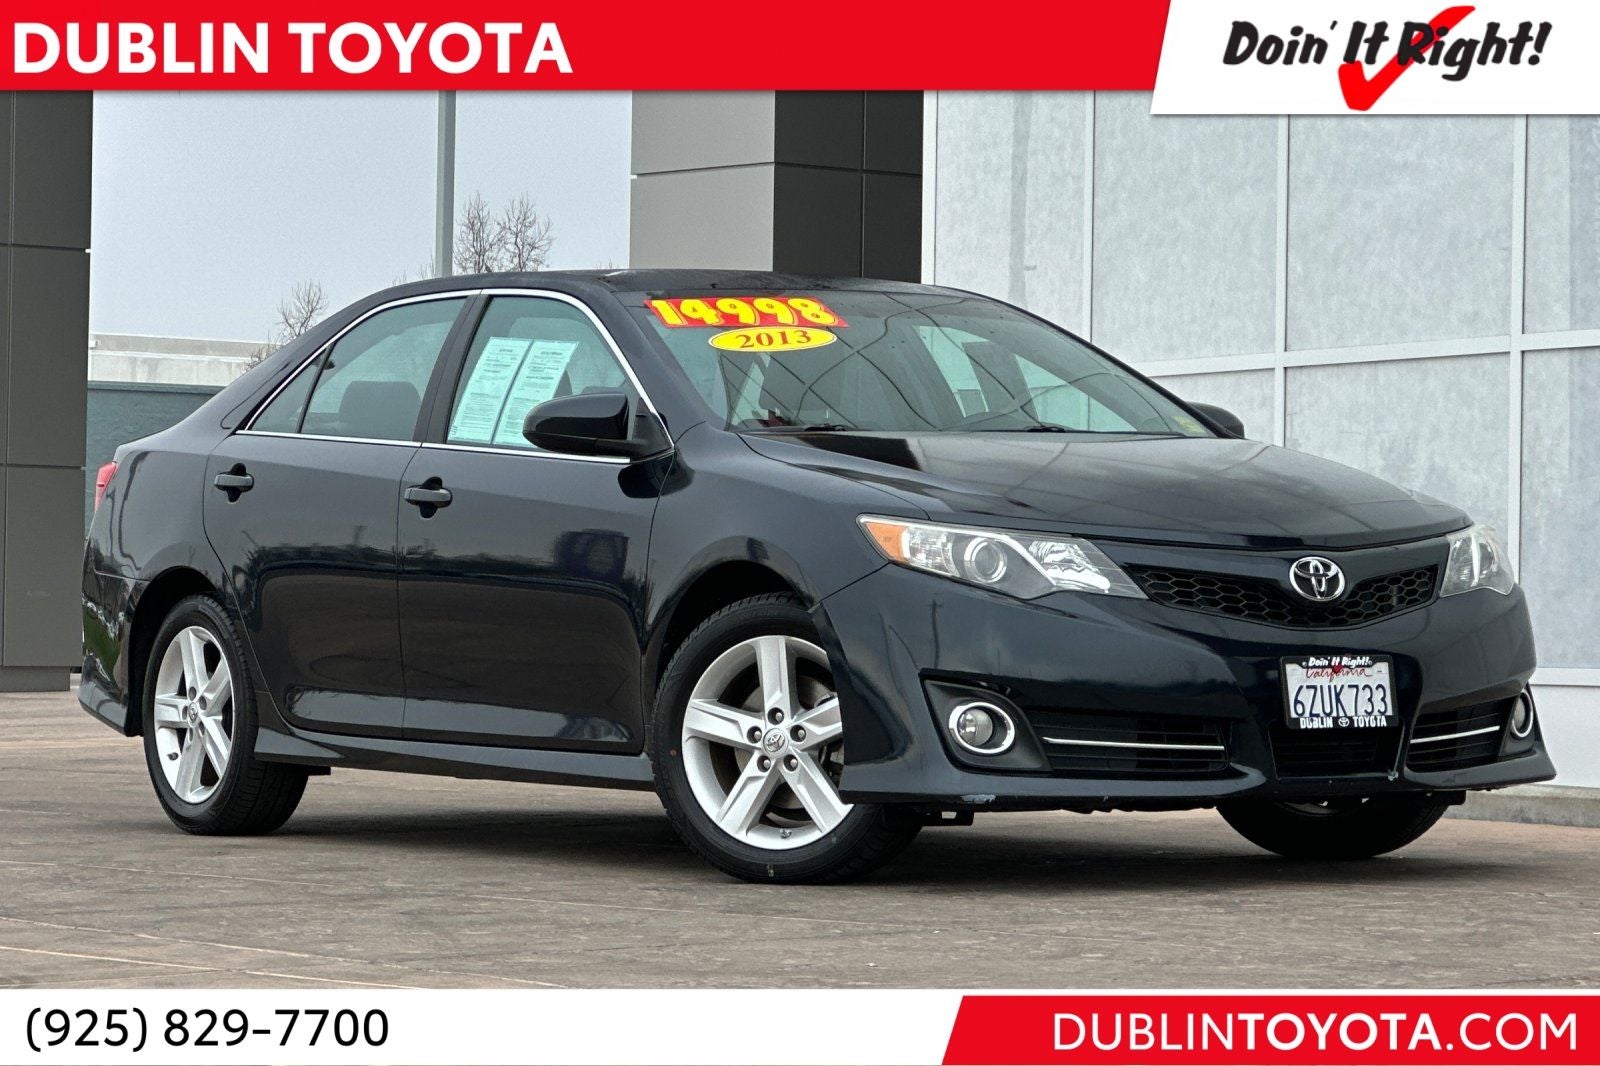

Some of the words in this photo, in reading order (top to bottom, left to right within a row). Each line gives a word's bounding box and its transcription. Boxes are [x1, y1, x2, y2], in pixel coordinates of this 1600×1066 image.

[651, 297, 839, 325] 14998
[736, 330, 811, 348] 2013
[1308, 656, 1330, 667] Doin'
[1331, 656, 1340, 666] It
[1341, 656, 1370, 669] Right!
[1293, 684, 1388, 717] 6ZUK733
[1299, 717, 1333, 729] DUBLIN
[1353, 716, 1387, 728] TOYOTA
